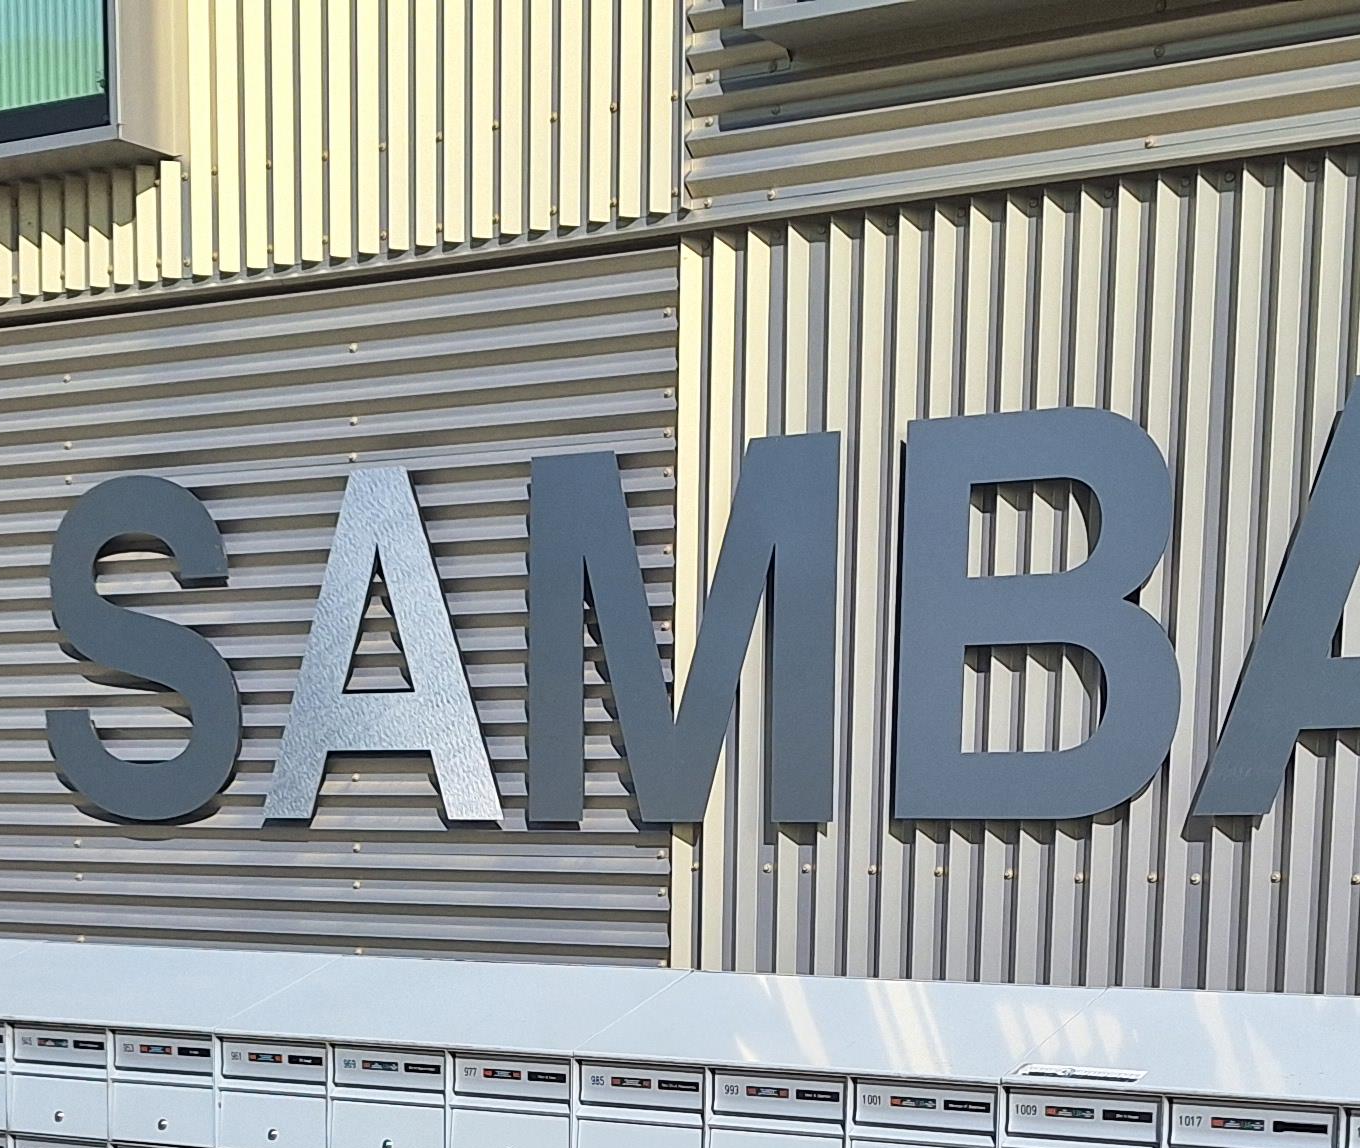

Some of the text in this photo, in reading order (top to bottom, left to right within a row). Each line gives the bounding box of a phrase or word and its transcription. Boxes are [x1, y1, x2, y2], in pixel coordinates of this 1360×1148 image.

[590, 1075, 605, 1086] 985
[724, 1084, 739, 1095] 993
[862, 1094, 882, 1106] 1001
[1015, 1104, 1037, 1116] 1009
[1179, 1116, 1202, 1128] 1017
